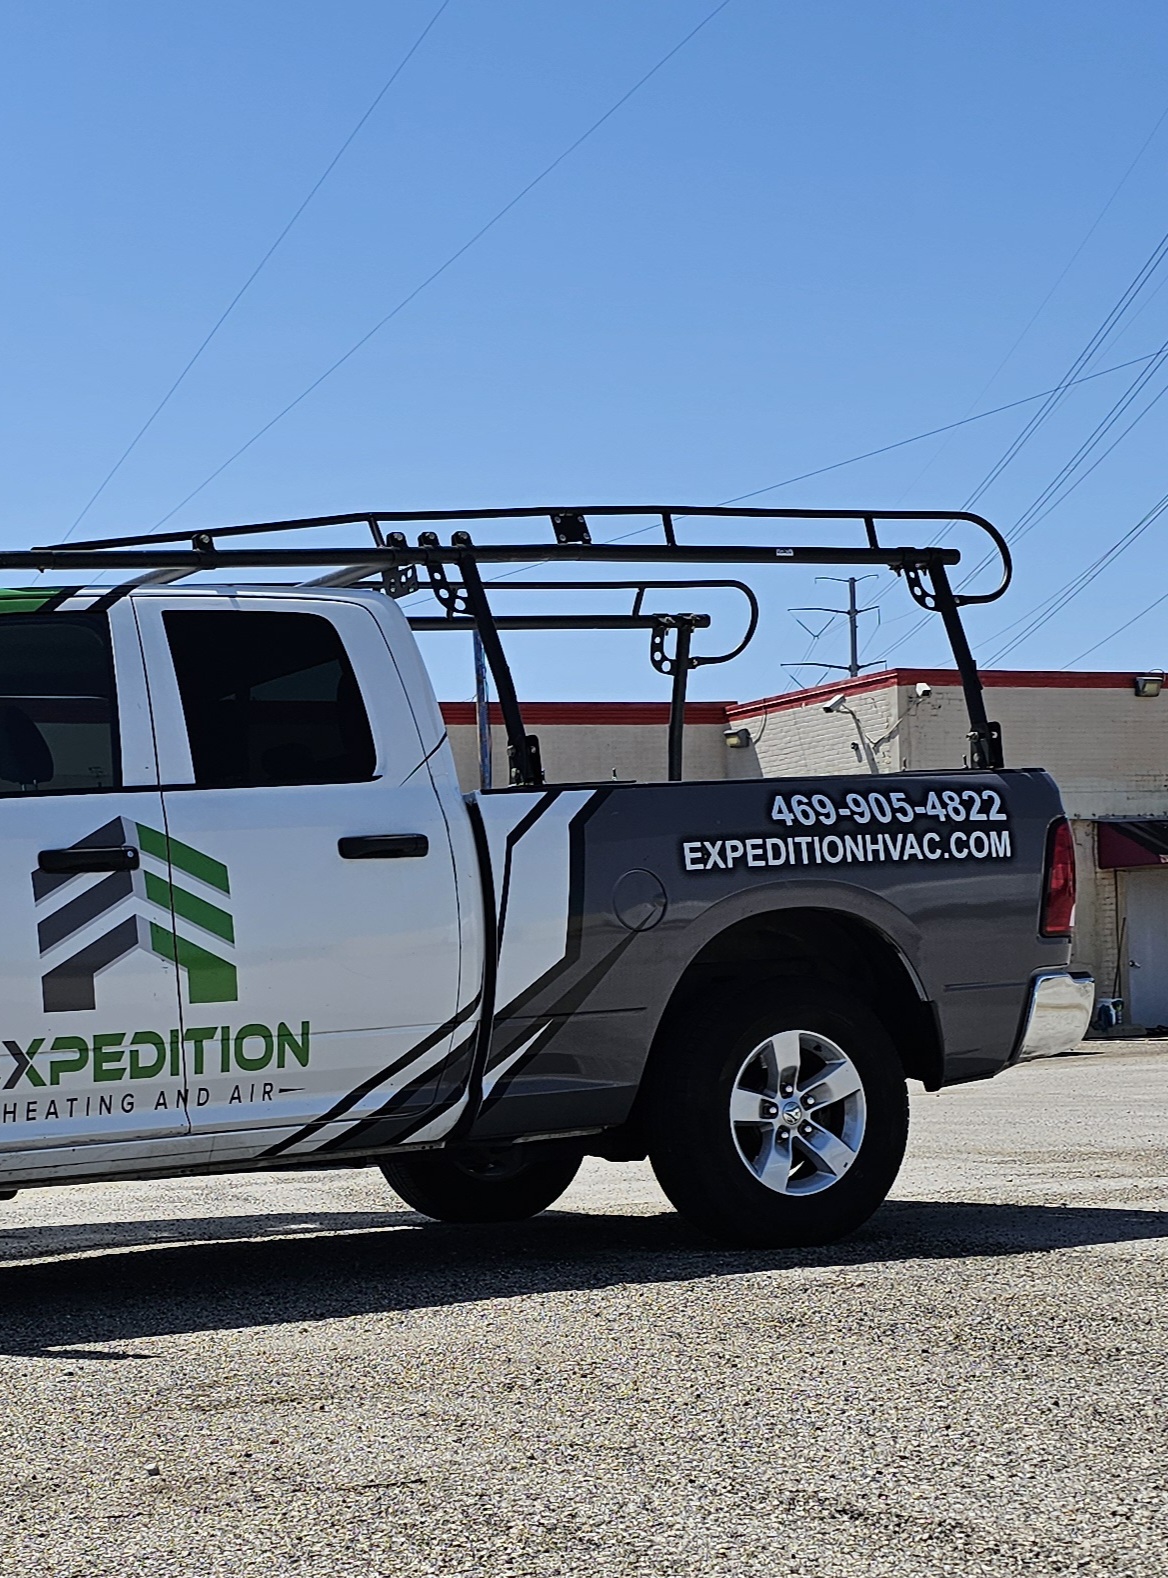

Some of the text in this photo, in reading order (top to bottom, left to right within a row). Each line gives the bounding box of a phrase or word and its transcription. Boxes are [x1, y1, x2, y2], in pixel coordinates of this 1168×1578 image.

[770, 790, 1007, 827] 469-905-4822
[683, 830, 1011, 871] EXPEDITIONHVAC.COM
[2, 1082, 275, 1124] HEATING AND AIR
